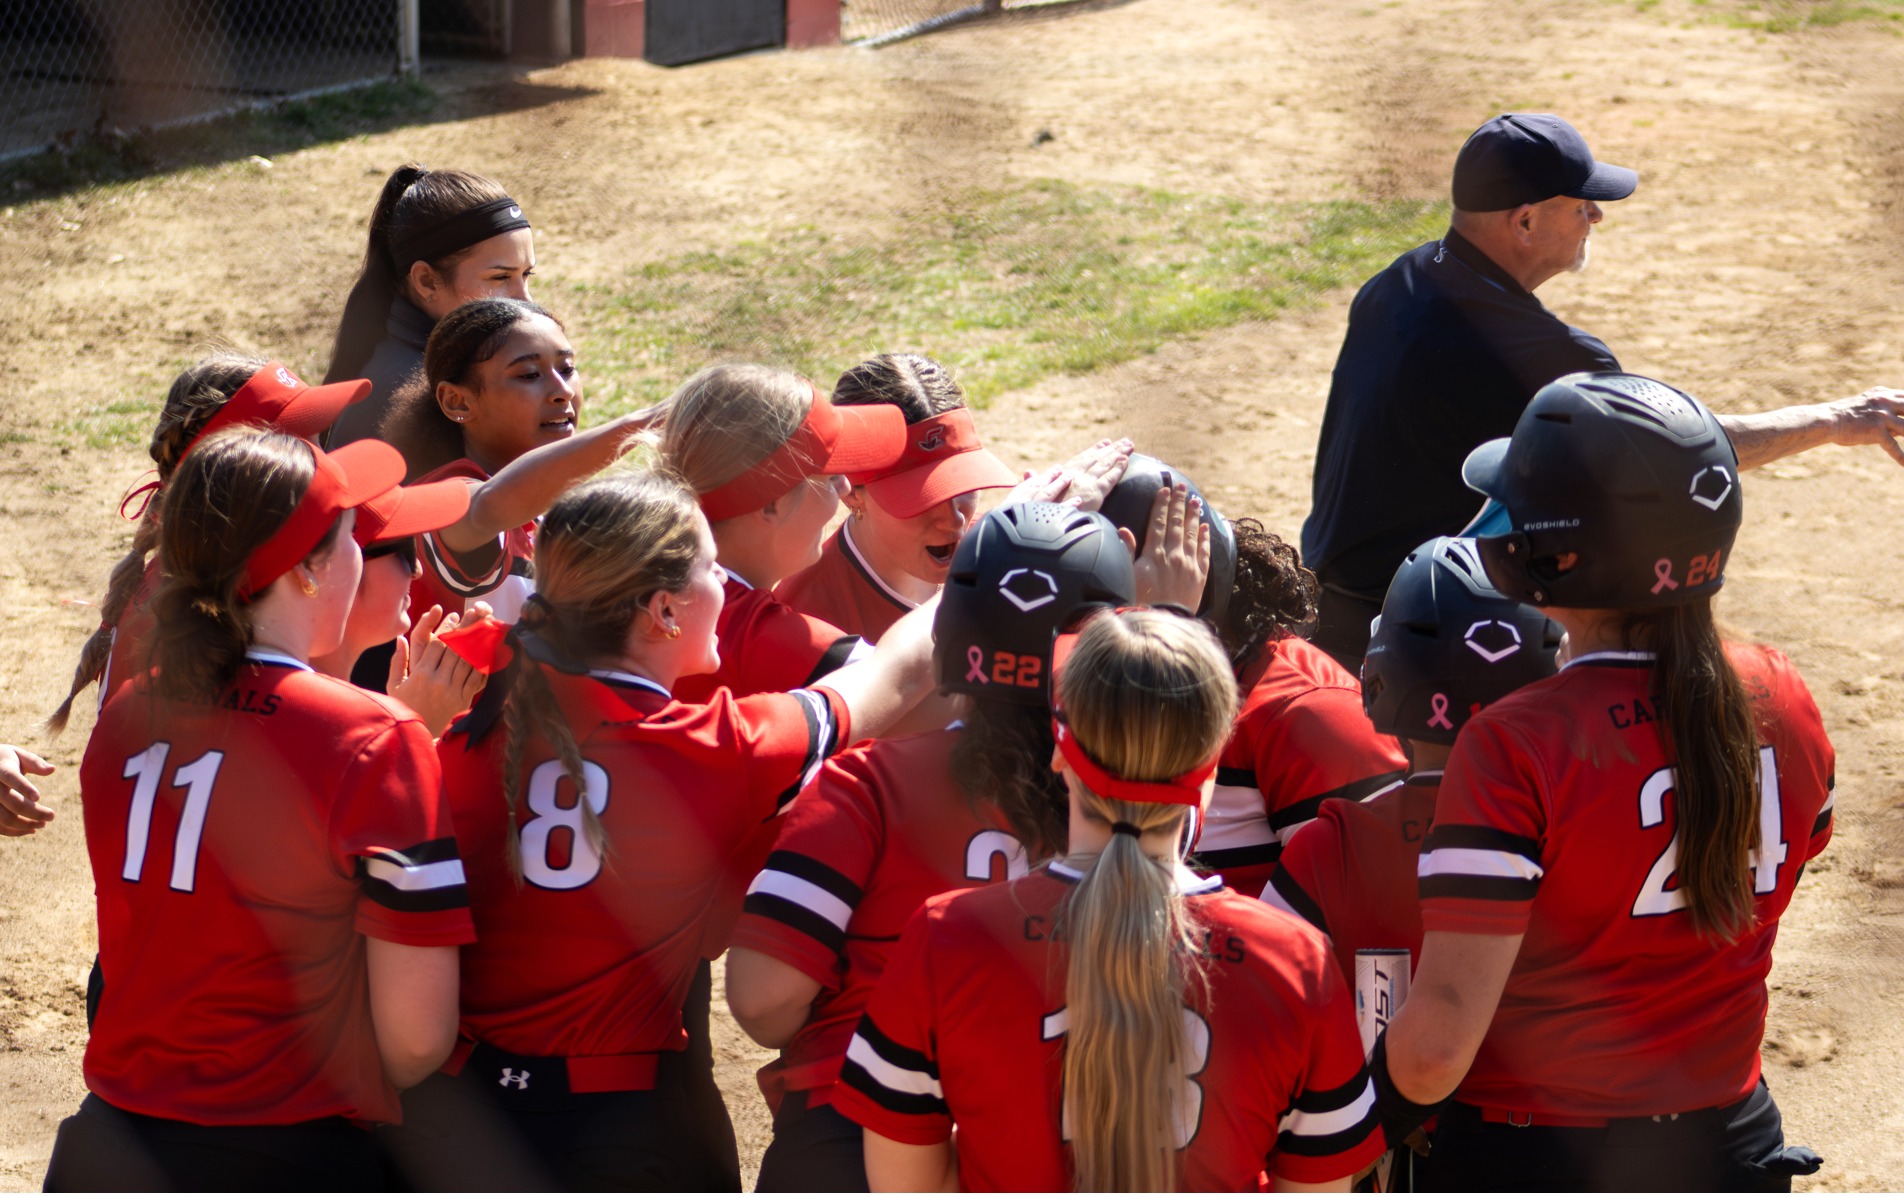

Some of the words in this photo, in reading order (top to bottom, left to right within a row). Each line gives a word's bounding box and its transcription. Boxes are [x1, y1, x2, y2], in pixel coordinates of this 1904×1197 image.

[1524, 518, 1580, 531] EVOSHIELD
[1685, 549, 1721, 587] 24
[992, 651, 1042, 688] 22
[122, 740, 225, 894] 11
[518, 758, 611, 892] 8
